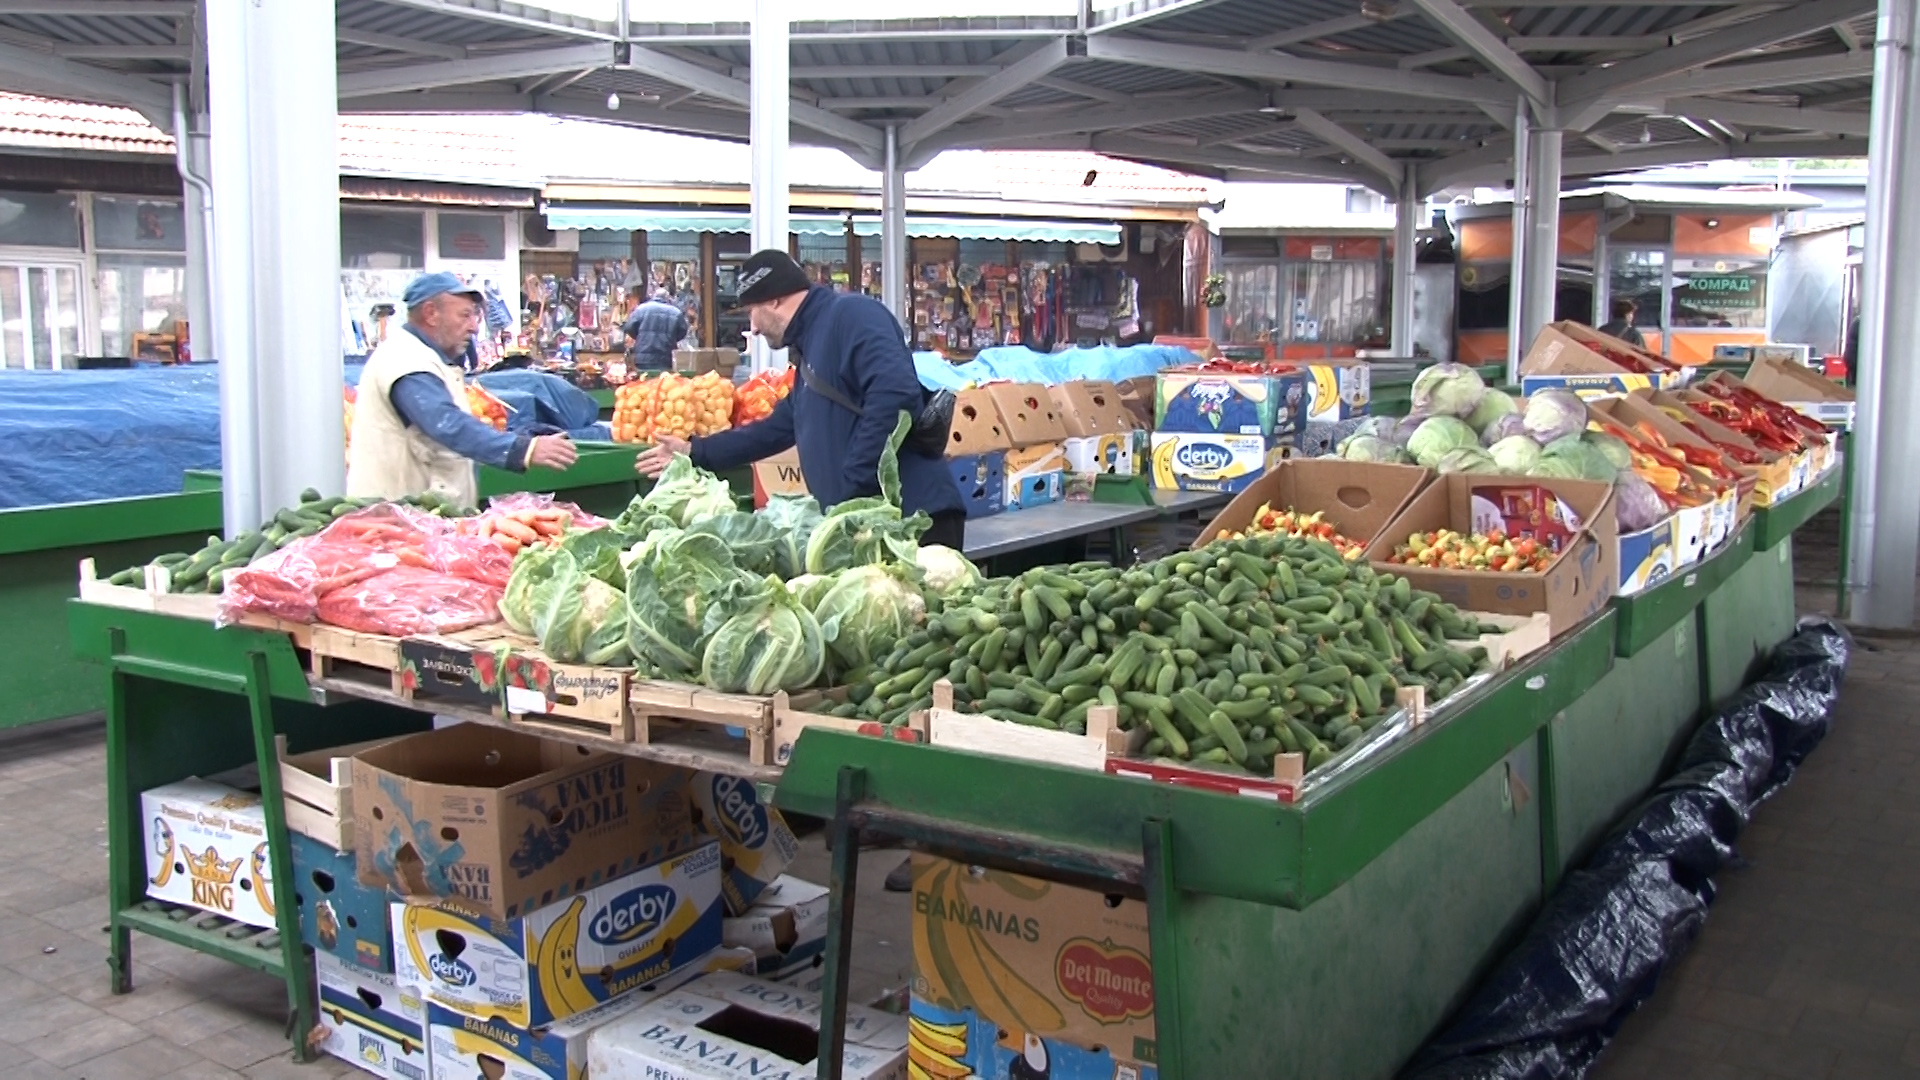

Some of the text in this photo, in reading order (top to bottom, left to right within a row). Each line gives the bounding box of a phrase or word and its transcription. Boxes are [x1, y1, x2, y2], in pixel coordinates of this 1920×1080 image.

[1180, 443, 1229, 469] derby
[556, 762, 627, 808] BANA
[567, 792, 629, 834] TICO
[715, 773, 765, 848] derby
[191, 878, 235, 912] KING
[595, 889, 671, 939] derby
[915, 890, 1041, 943] BANANAS
[617, 937, 656, 960] QUALITY
[431, 953, 473, 988] derby
[609, 960, 671, 996] BANANAS
[1064, 959, 1152, 1000] Del Monte
[463, 1016, 520, 1047] BANANAS
